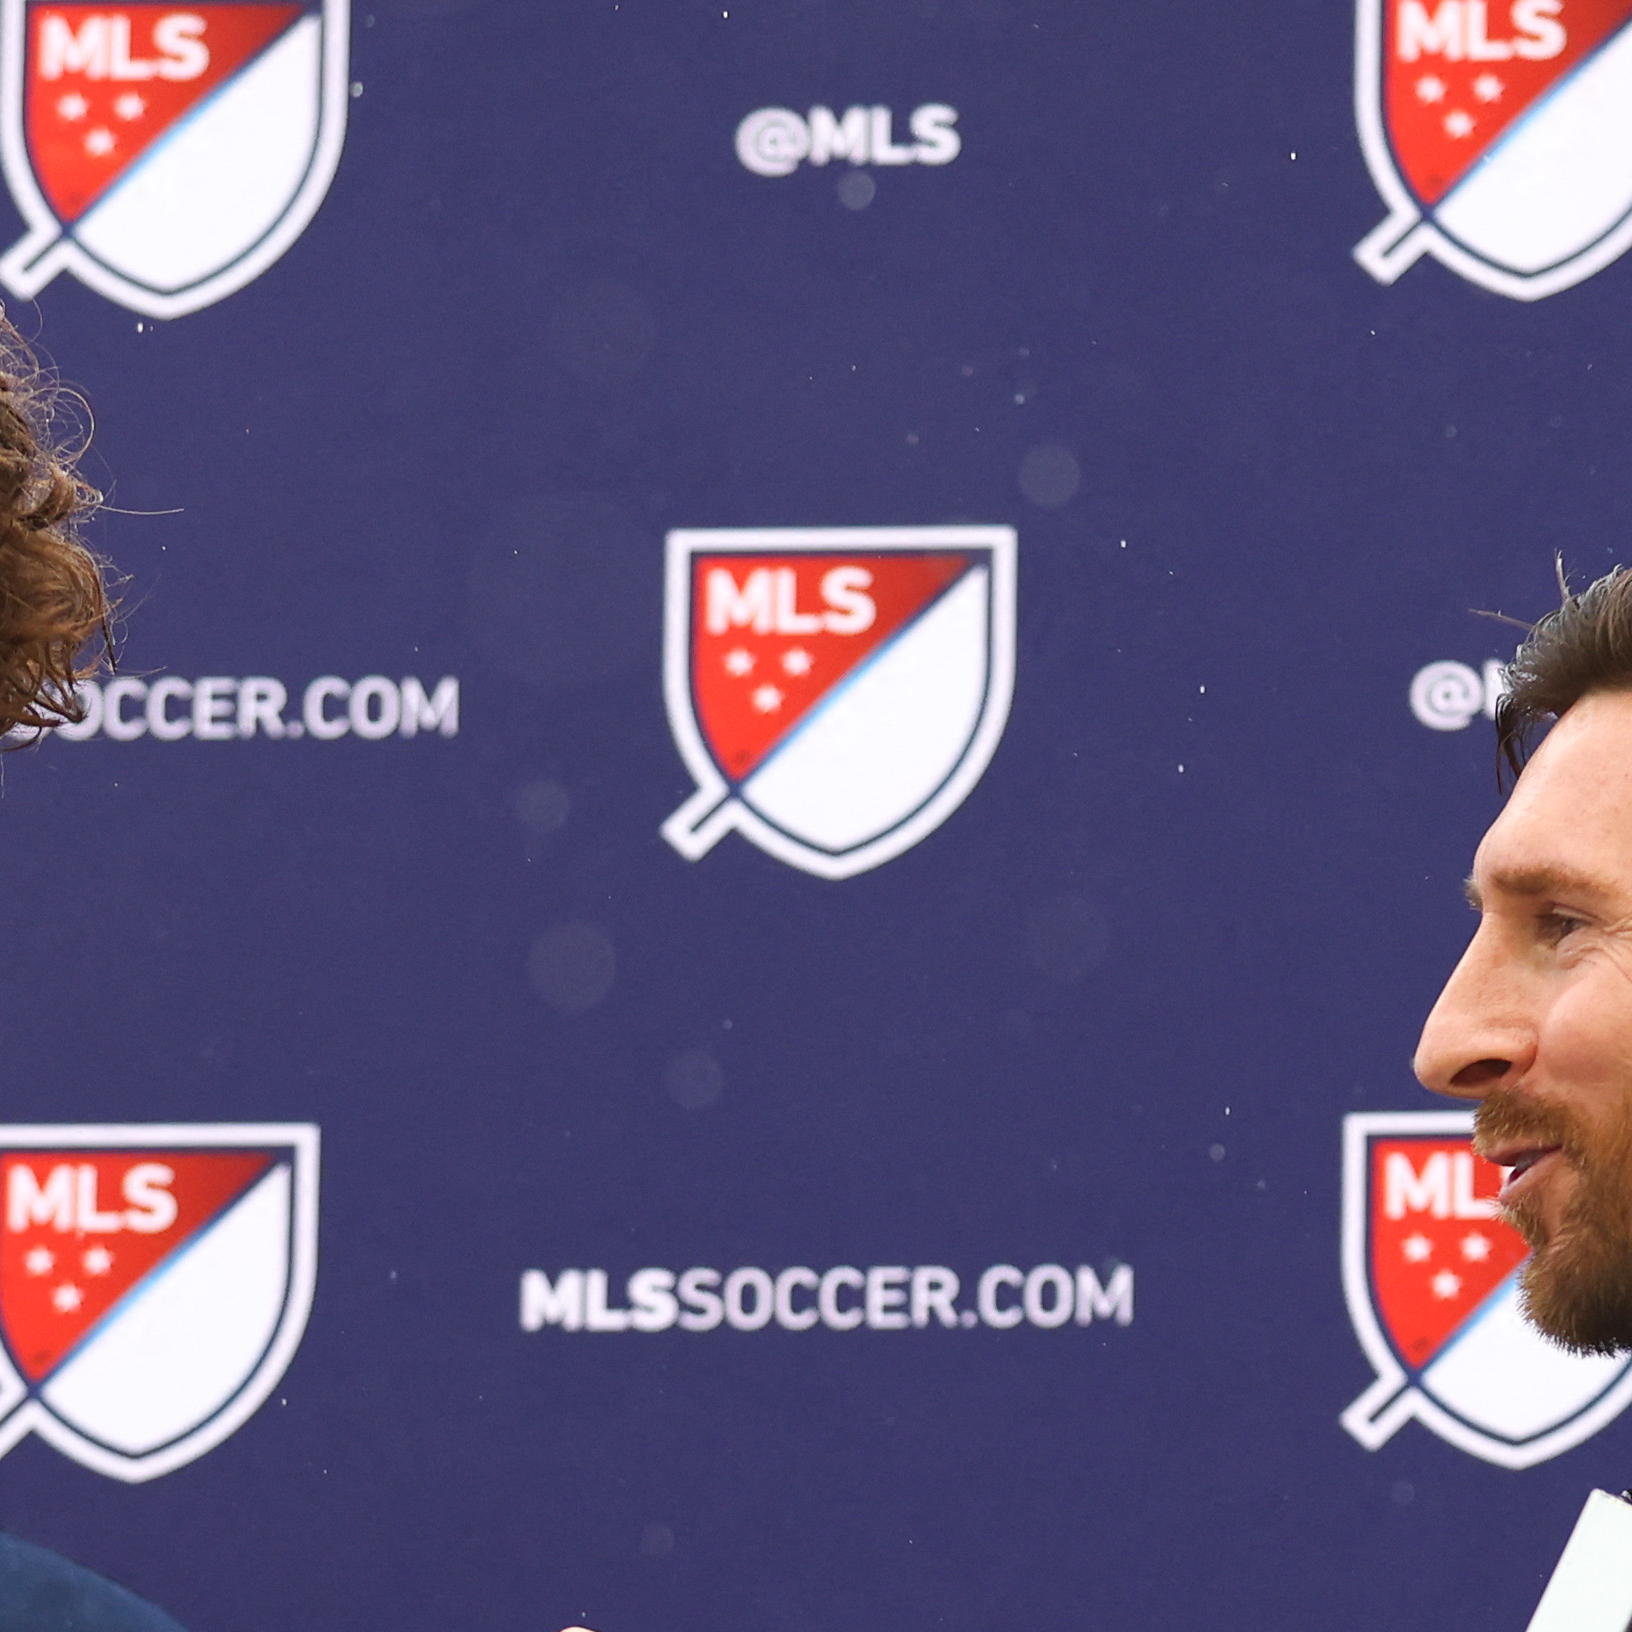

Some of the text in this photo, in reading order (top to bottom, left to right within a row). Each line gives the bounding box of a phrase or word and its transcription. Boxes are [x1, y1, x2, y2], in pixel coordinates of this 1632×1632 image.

[39, 14, 209, 80] MLS
[1397, 0, 1566, 62] MLS
[736, 104, 960, 176] @MLS
[706, 566, 876, 634] MLS
[7, 1163, 177, 1236] MLS
[1384, 1150, 1516, 1221] ML
[520, 1265, 1133, 1331] MLSSOCCER.COM
